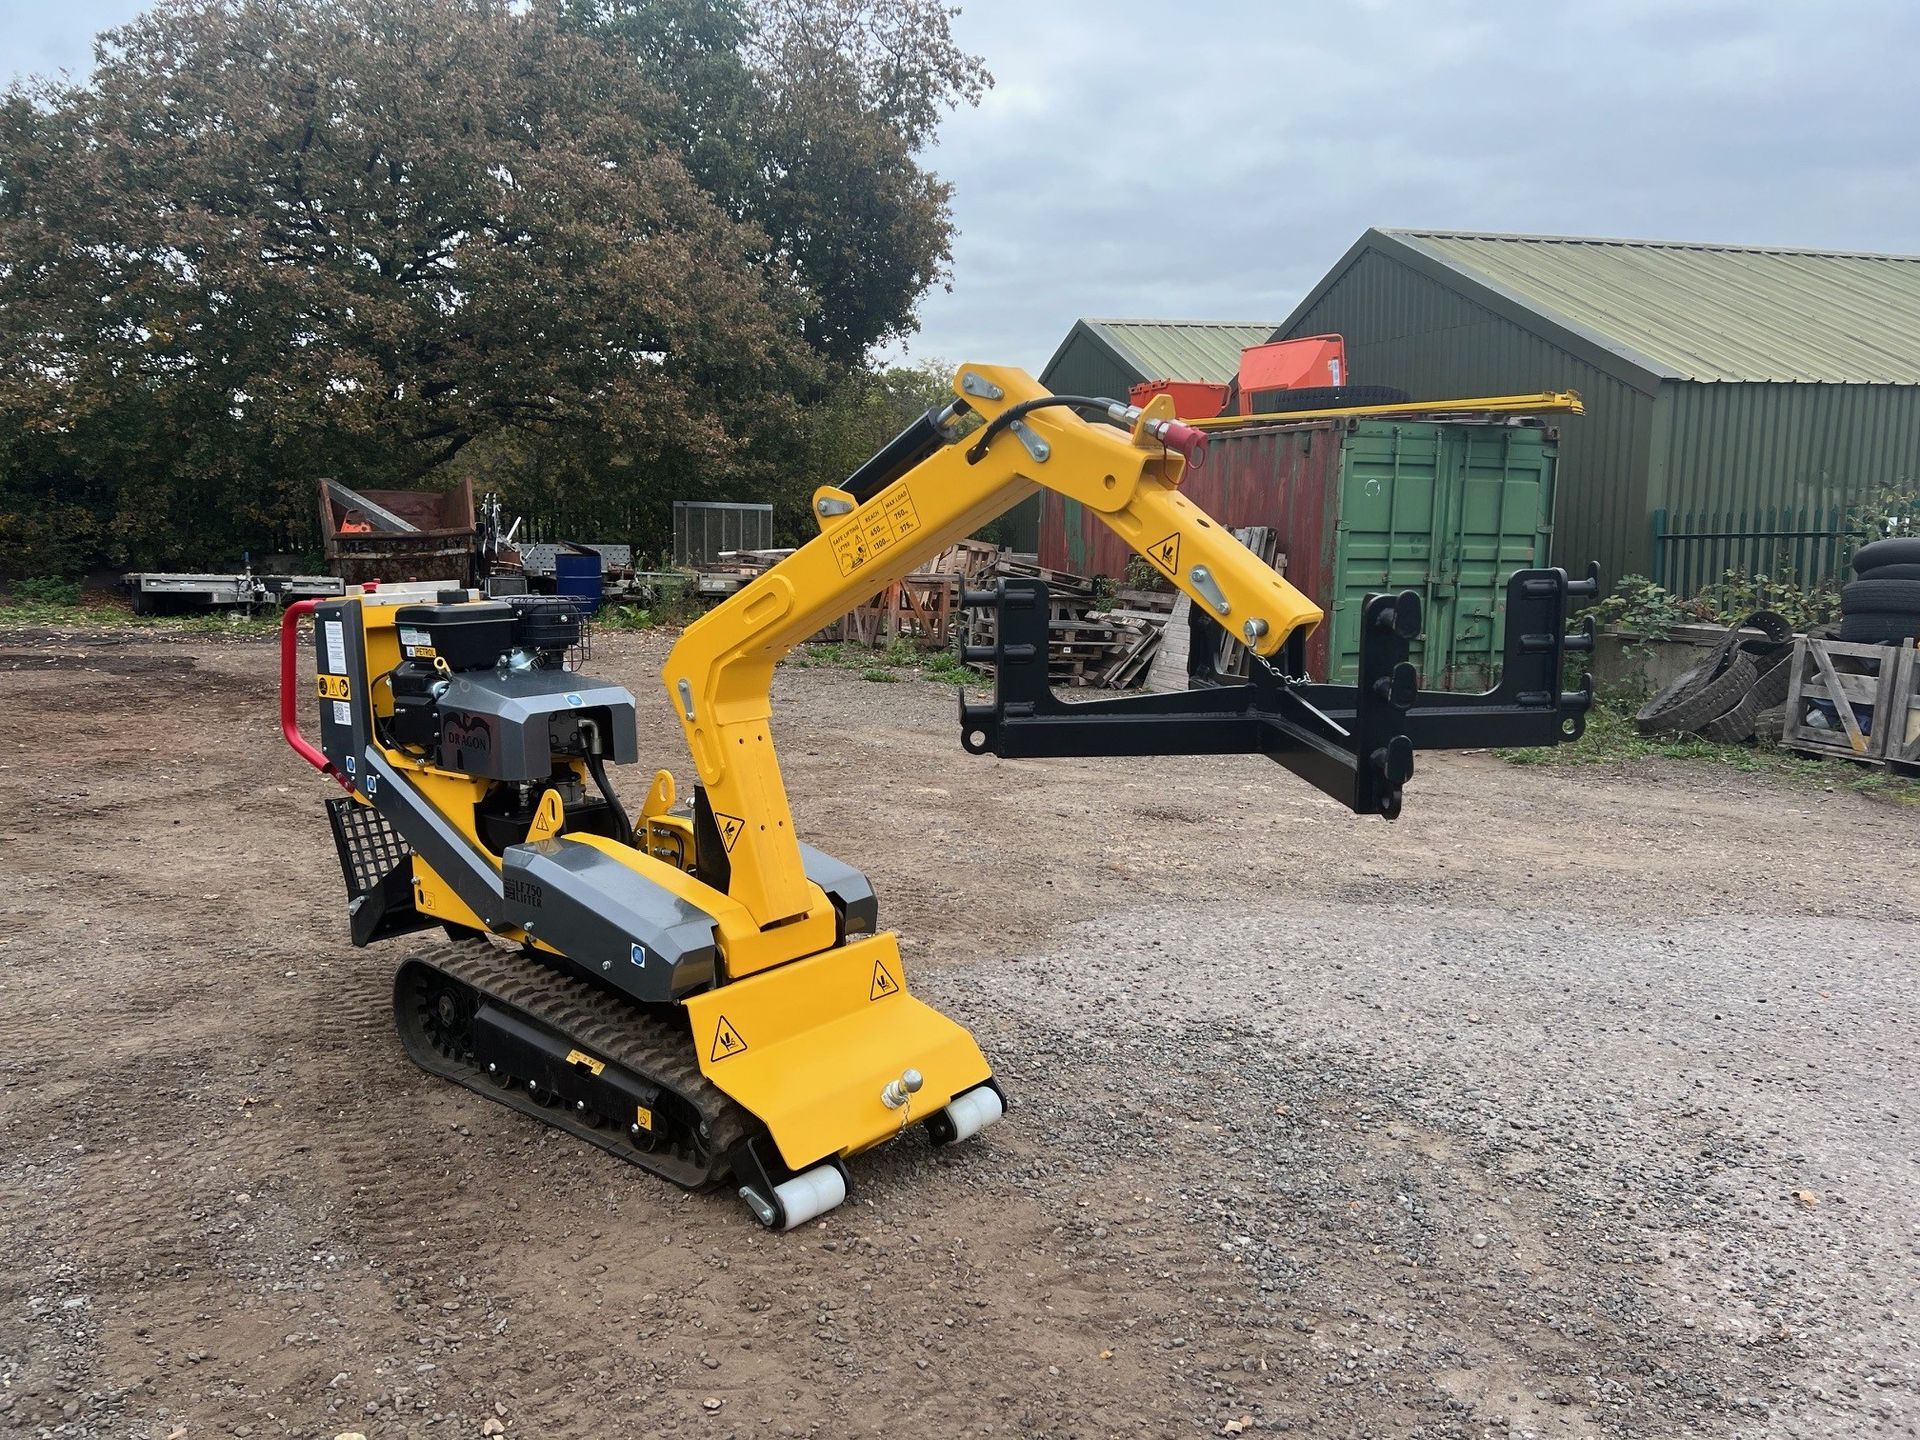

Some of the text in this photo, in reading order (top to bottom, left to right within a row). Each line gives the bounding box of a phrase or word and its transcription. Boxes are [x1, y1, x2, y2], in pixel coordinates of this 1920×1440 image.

[865, 511, 879, 522] REACH
[415, 647, 436, 657] PETROL
[448, 732, 488, 752] DRAGON
[516, 891, 543, 910] LIFTER
